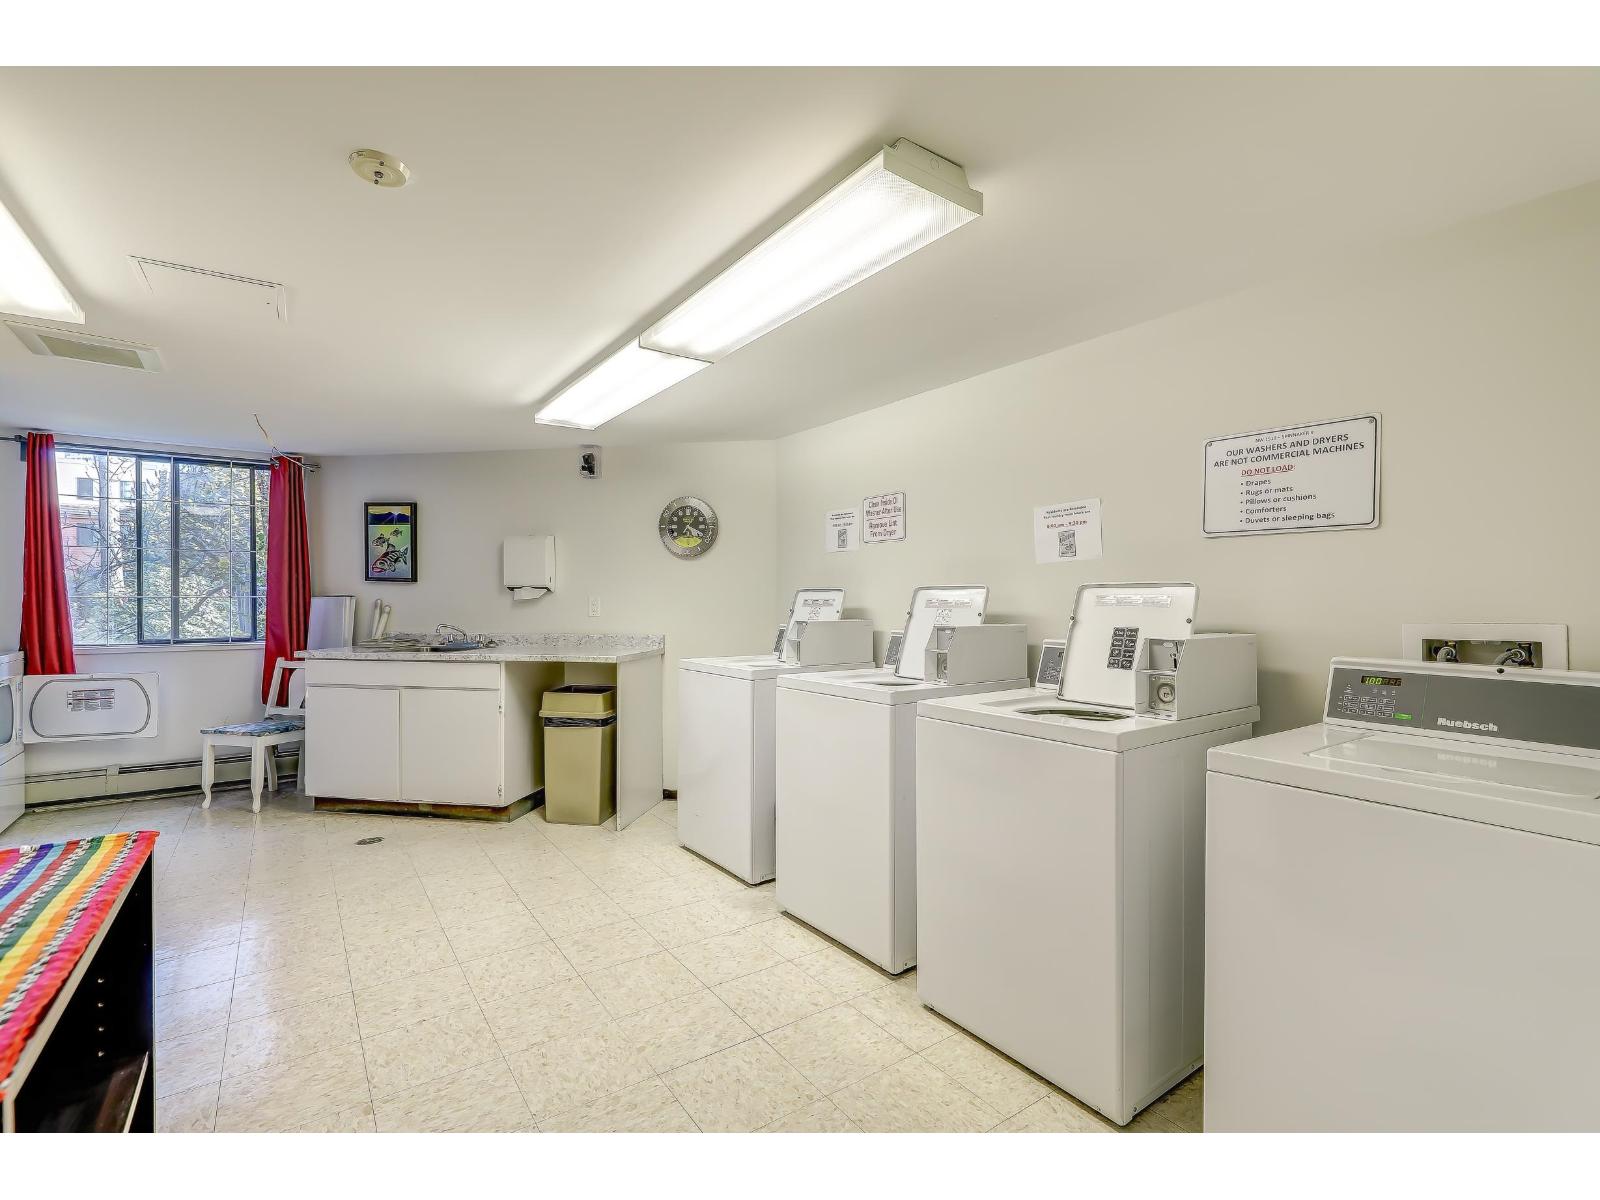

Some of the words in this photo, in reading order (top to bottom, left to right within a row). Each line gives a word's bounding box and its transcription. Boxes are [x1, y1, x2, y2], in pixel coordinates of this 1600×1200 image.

[1226, 448, 1244, 457] OUR
[1246, 442, 1288, 454] WASHERS
[1289, 440, 1310, 448] AND
[1312, 434, 1349, 446] DRYERS
[1214, 460, 1229, 468] ARE
[1231, 458, 1248, 466] NOT
[1250, 450, 1310, 463] COMMERCIAL
[1312, 442, 1365, 455] MACHINES
[1246, 478, 1271, 487] Drapes
[1246, 506, 1287, 514] Comforters
[1282, 513, 1314, 522] sleeping
[1316, 512, 1335, 520] bags
